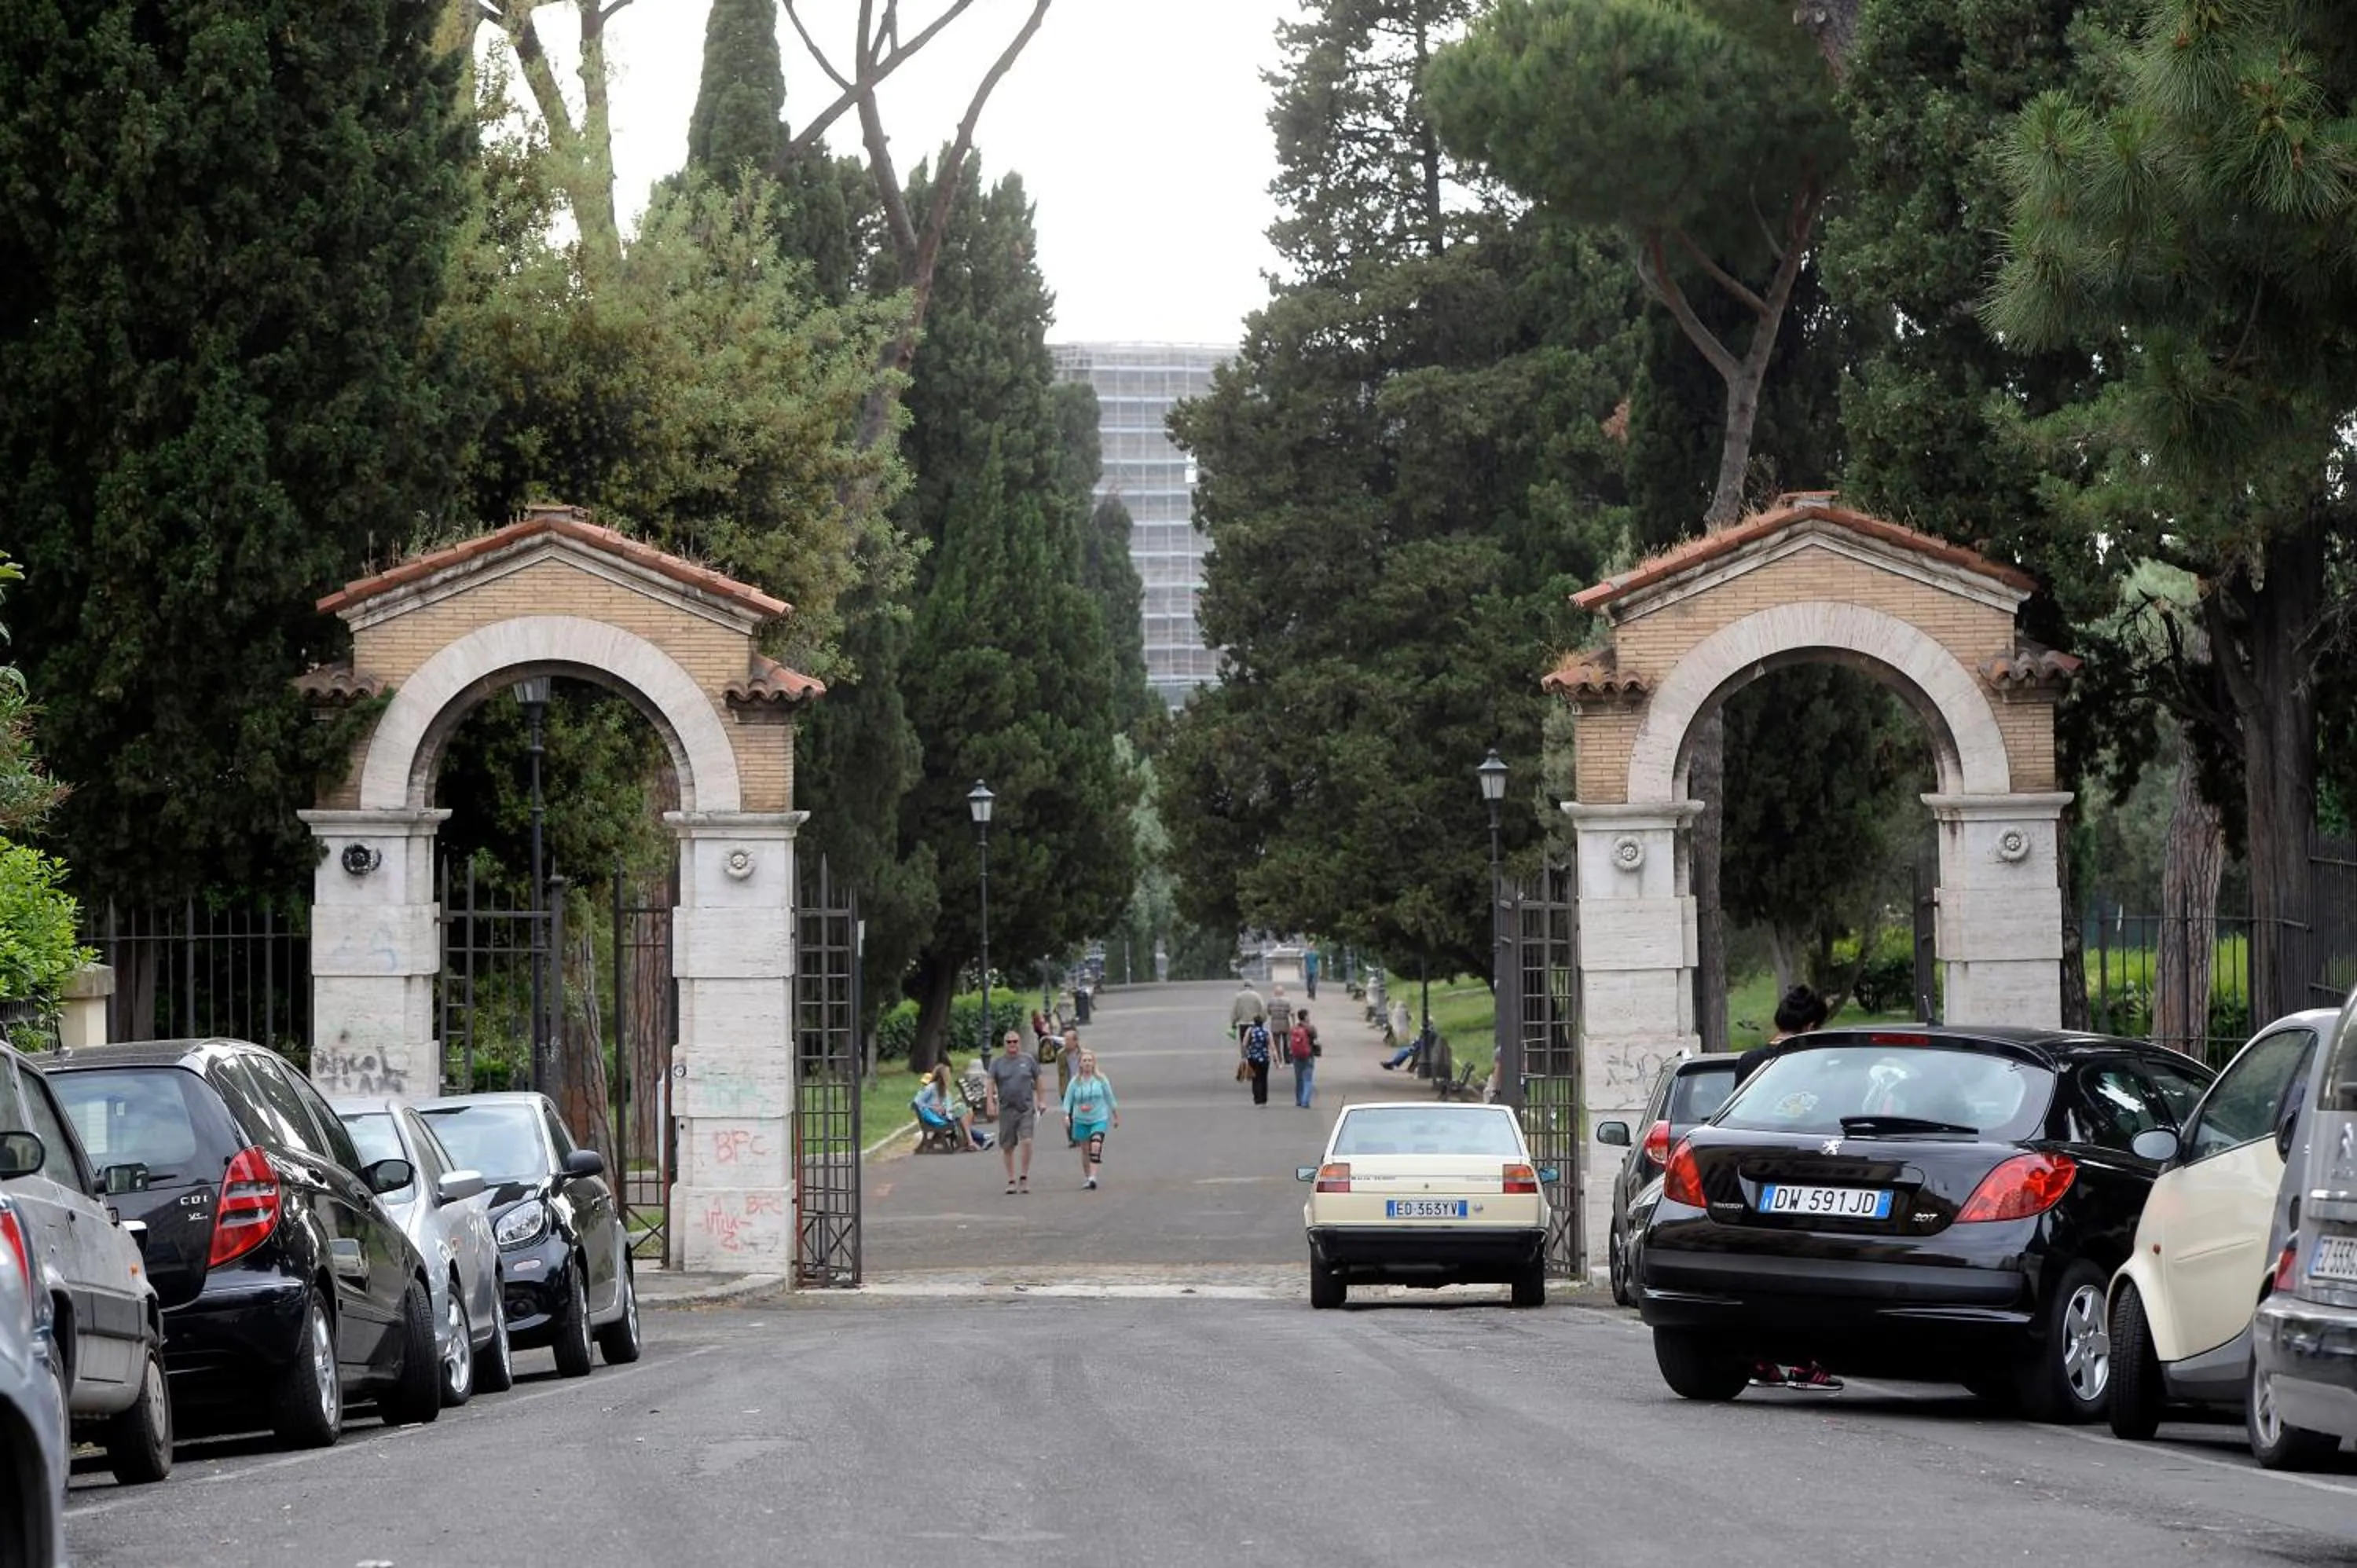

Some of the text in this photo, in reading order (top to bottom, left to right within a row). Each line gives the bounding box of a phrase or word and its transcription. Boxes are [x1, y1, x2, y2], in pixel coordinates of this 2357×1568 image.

[1418, 1203, 1457, 1215] 363YV
[1774, 1188, 1802, 1211] DW
[1809, 1189, 1876, 1214] 591JD
